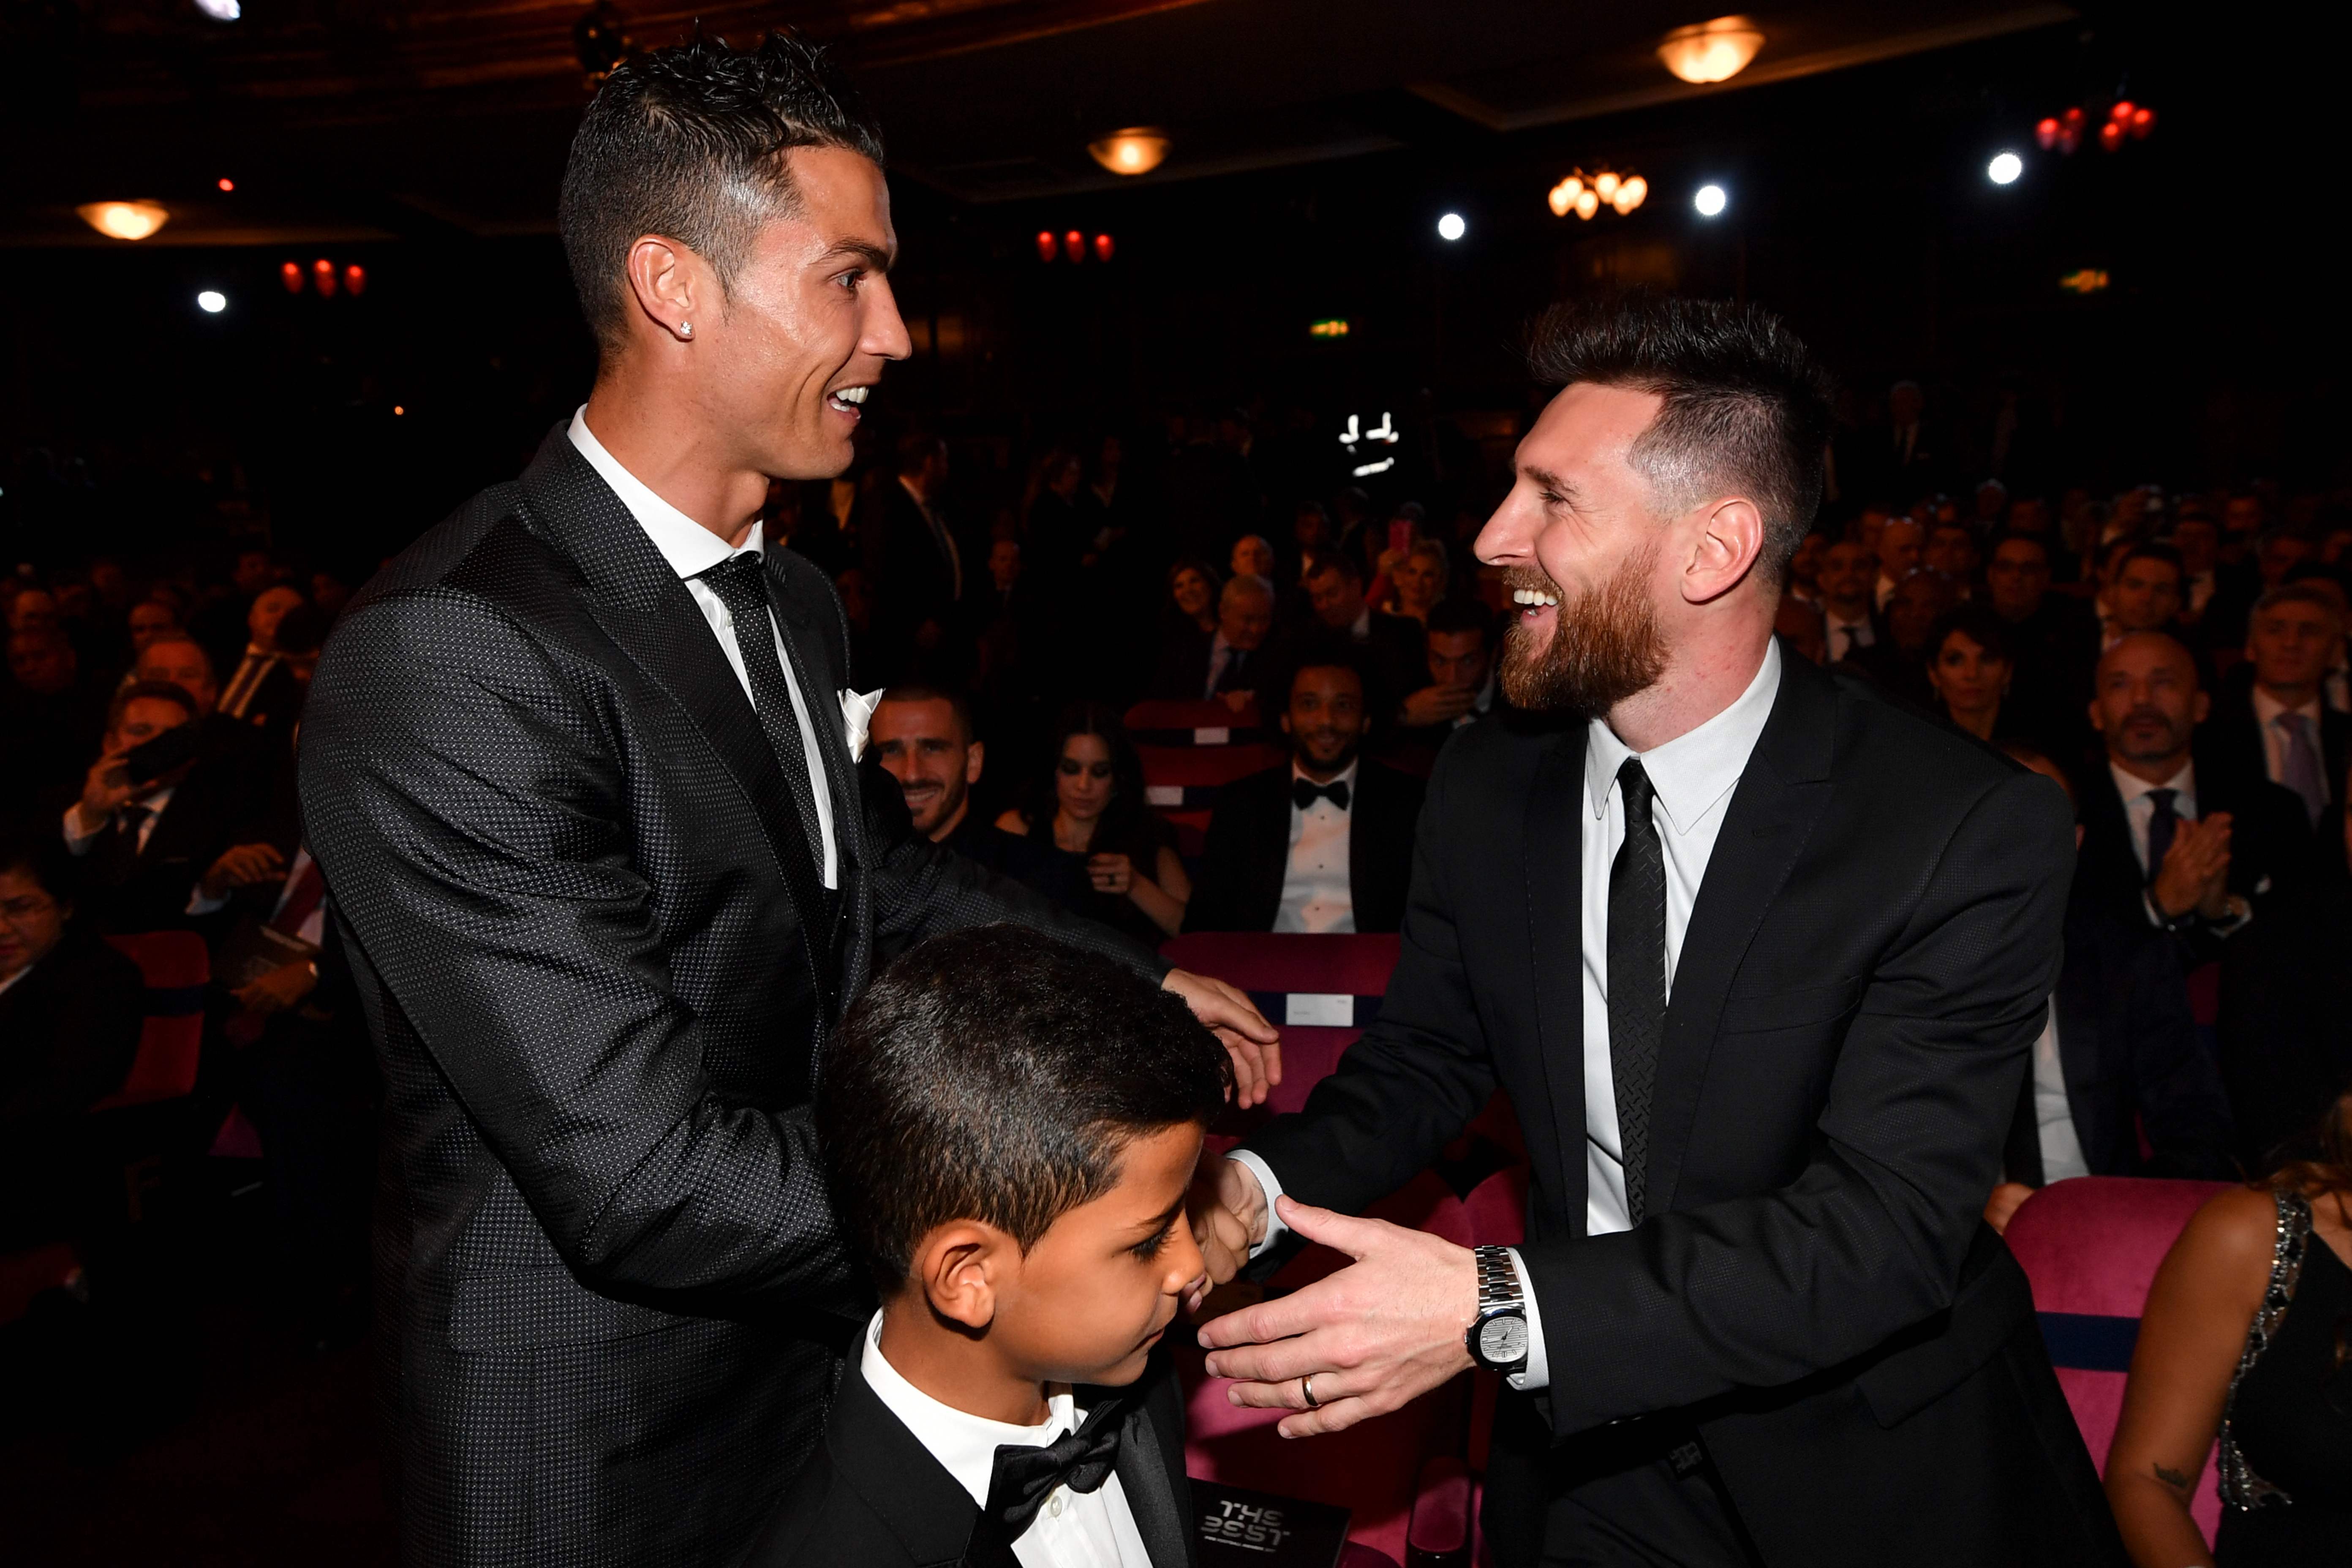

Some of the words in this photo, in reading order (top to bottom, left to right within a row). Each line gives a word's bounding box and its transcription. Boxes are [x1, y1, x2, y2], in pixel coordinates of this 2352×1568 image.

[122, 1155, 162, 1223] F
[1221, 1500, 1283, 1526] THE
[1201, 1516, 1290, 1546] BEST
